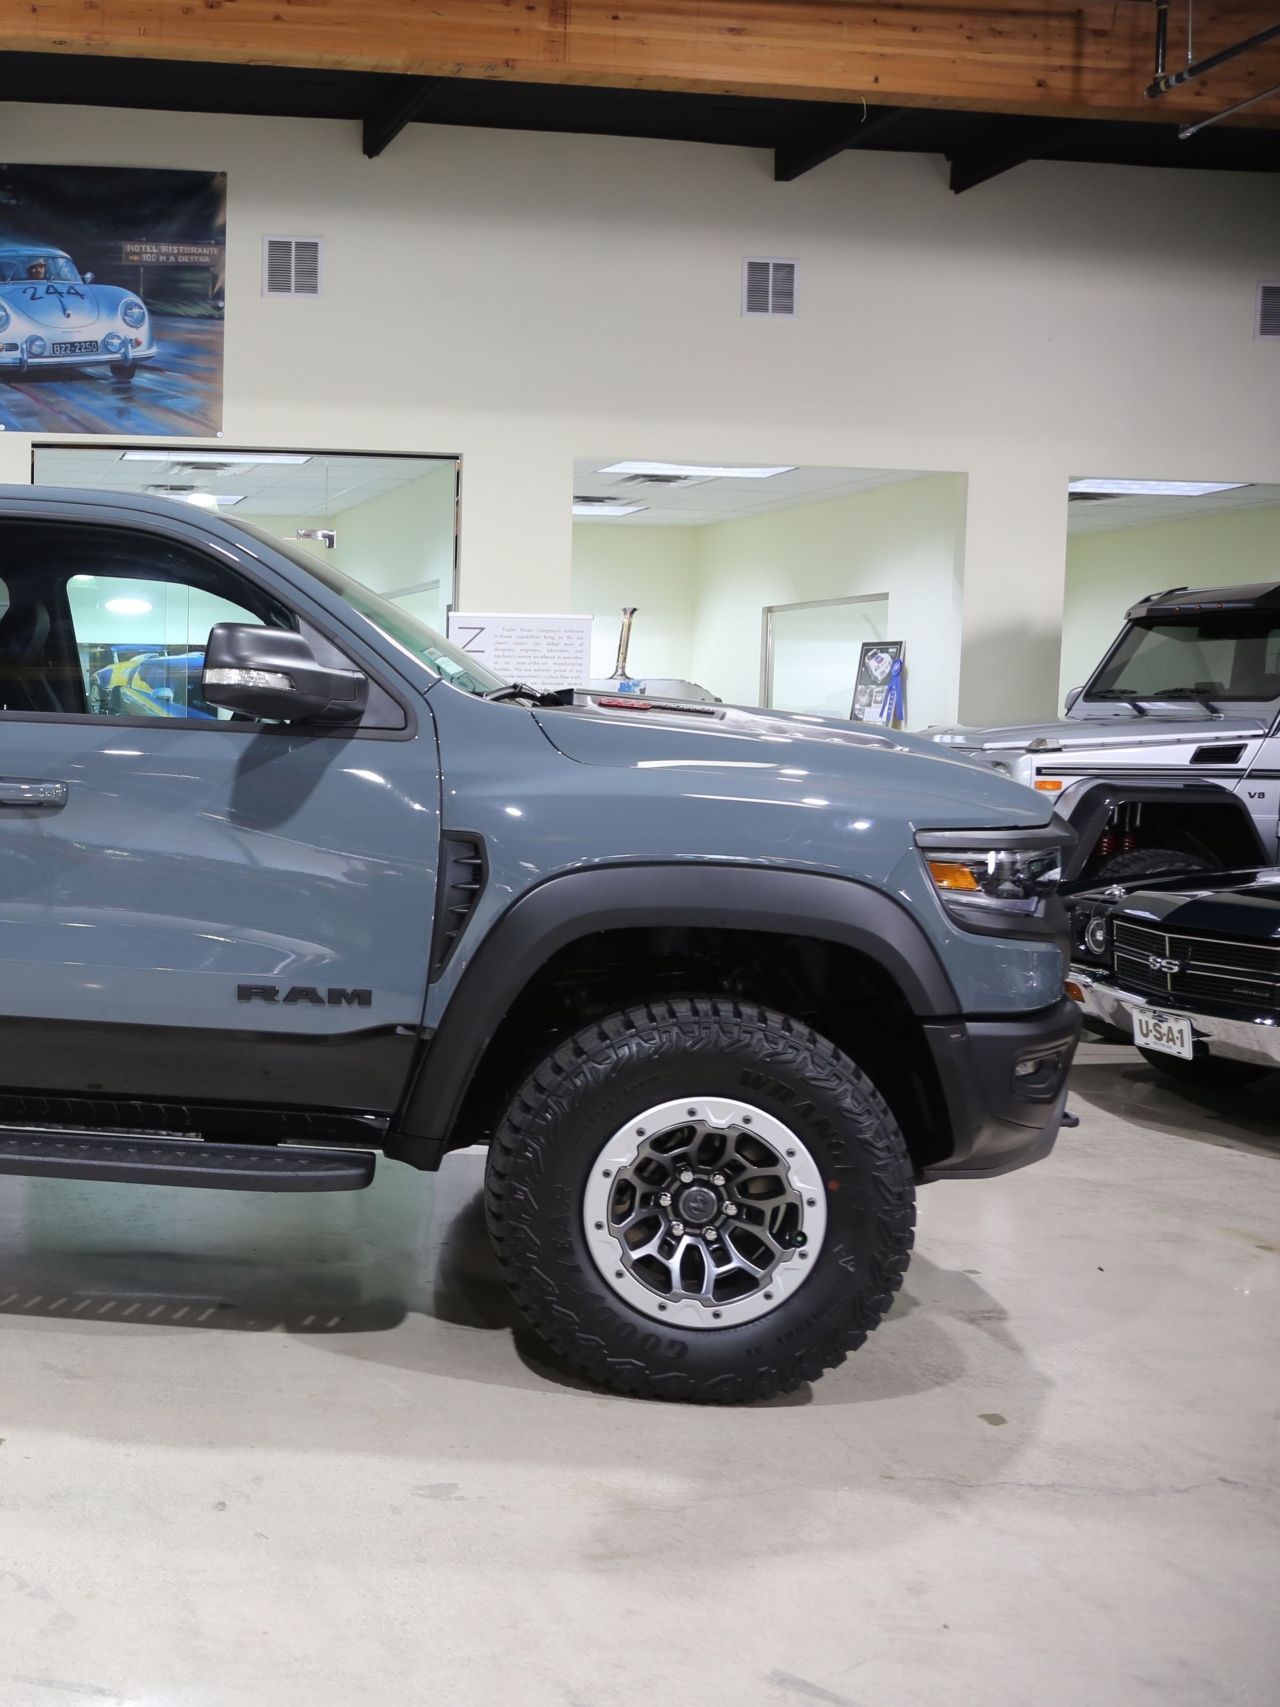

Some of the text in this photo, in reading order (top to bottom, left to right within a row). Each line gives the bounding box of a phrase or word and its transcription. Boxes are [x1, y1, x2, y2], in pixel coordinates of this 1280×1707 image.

[126, 244, 219, 255] HOTEL RISTORANTE
[141, 254, 157, 262] 100
[178, 255, 210, 263] DESTRA
[22, 284, 86, 301] 244
[1247, 791, 1266, 799] V8
[1148, 955, 1180, 973] SS
[237, 983, 373, 1008] RAM
[1232, 988, 1270, 998] CHEVELLE
